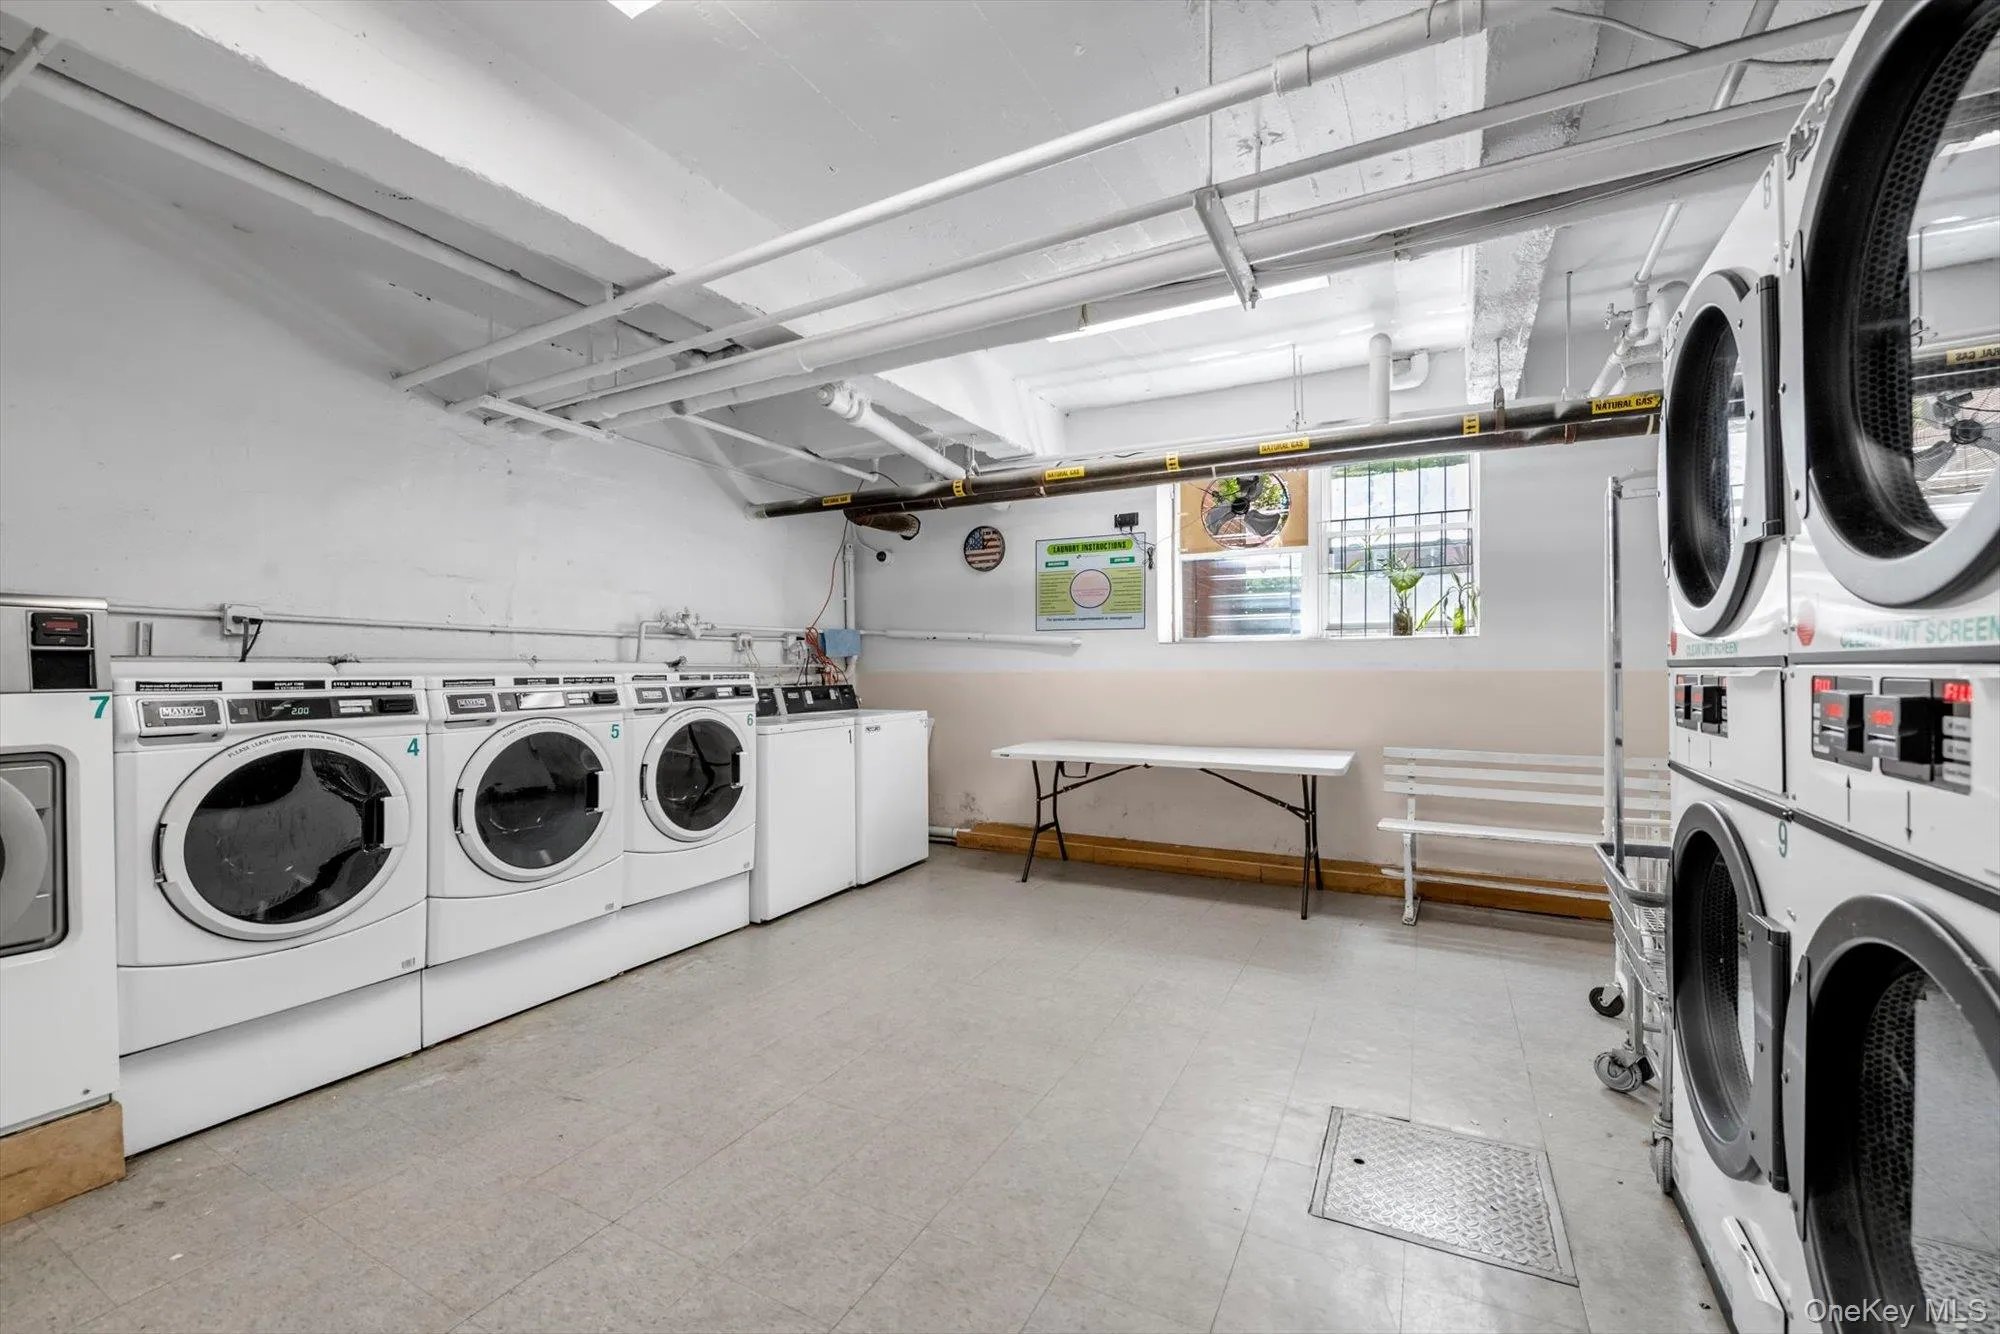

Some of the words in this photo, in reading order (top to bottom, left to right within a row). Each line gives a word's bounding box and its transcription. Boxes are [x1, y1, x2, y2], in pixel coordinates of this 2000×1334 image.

[1595, 400, 1633, 410] NATURAL
[1635, 396, 1653, 406] GAS
[1261, 441, 1289, 452] NATURAL
[1053, 544, 1080, 553] LAUNDRY
[1082, 541, 1126, 551] INSTRUCTIONS
[89, 695, 110, 719] 7
[162, 706, 204, 717] MAYTAG
[747, 713, 754, 726] 6
[611, 724, 620, 739] 5
[227, 745, 250, 758] PLEASE
[251, 739, 272, 748] LEAVE
[407, 738, 420, 756] 4
[1779, 821, 1788, 858] 9
